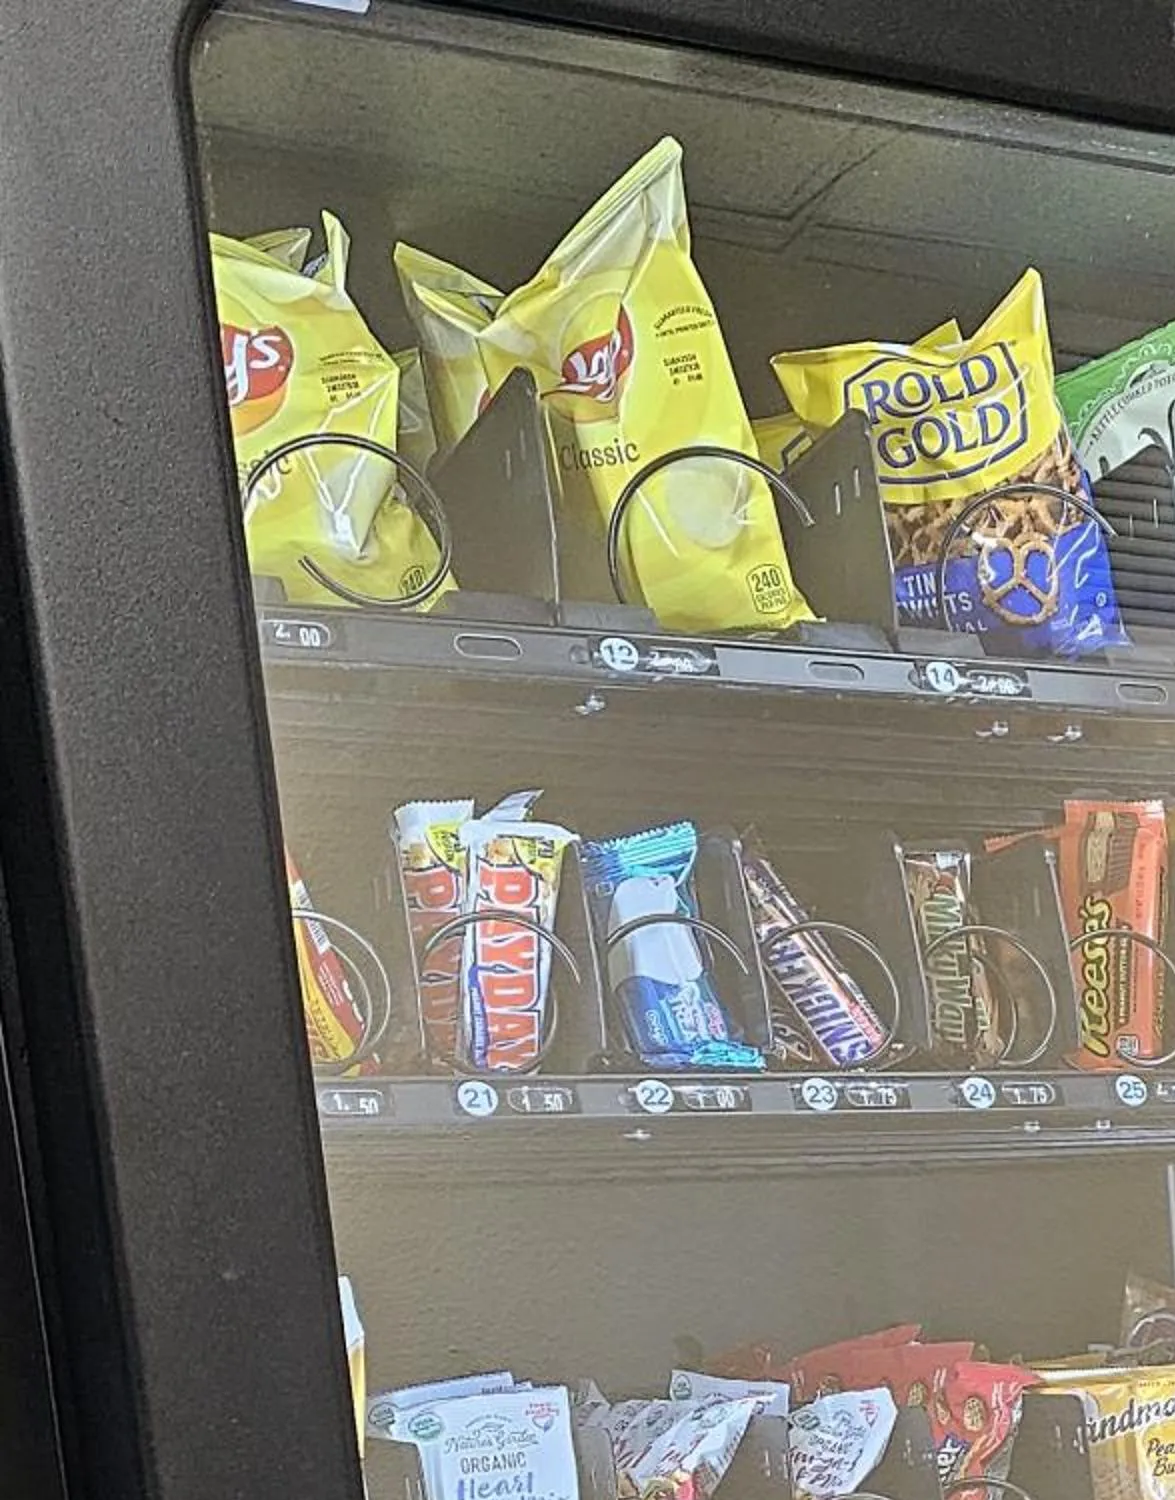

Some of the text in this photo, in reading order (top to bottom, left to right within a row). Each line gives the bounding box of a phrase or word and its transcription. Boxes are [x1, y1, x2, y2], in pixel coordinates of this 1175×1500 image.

[222, 335, 283, 406] y's
[863, 354, 997, 425] ROLD
[877, 400, 1011, 470] GOLD
[560, 439, 641, 472] Classic
[751, 569, 781, 592] 240
[602, 642, 634, 666] 12
[931, 669, 956, 690] 14
[478, 865, 543, 1069] PAYDAY
[1078, 897, 1113, 1057] Reese's
[757, 923, 873, 1066] SNICKERS
[463, 1088, 493, 1109] 21
[640, 1089, 670, 1106] 22
[806, 1086, 835, 1103] 23
[966, 1084, 995, 1101] 24
[1119, 1081, 1146, 1099] 25
[460, 1452, 527, 1475] ORGANIC
